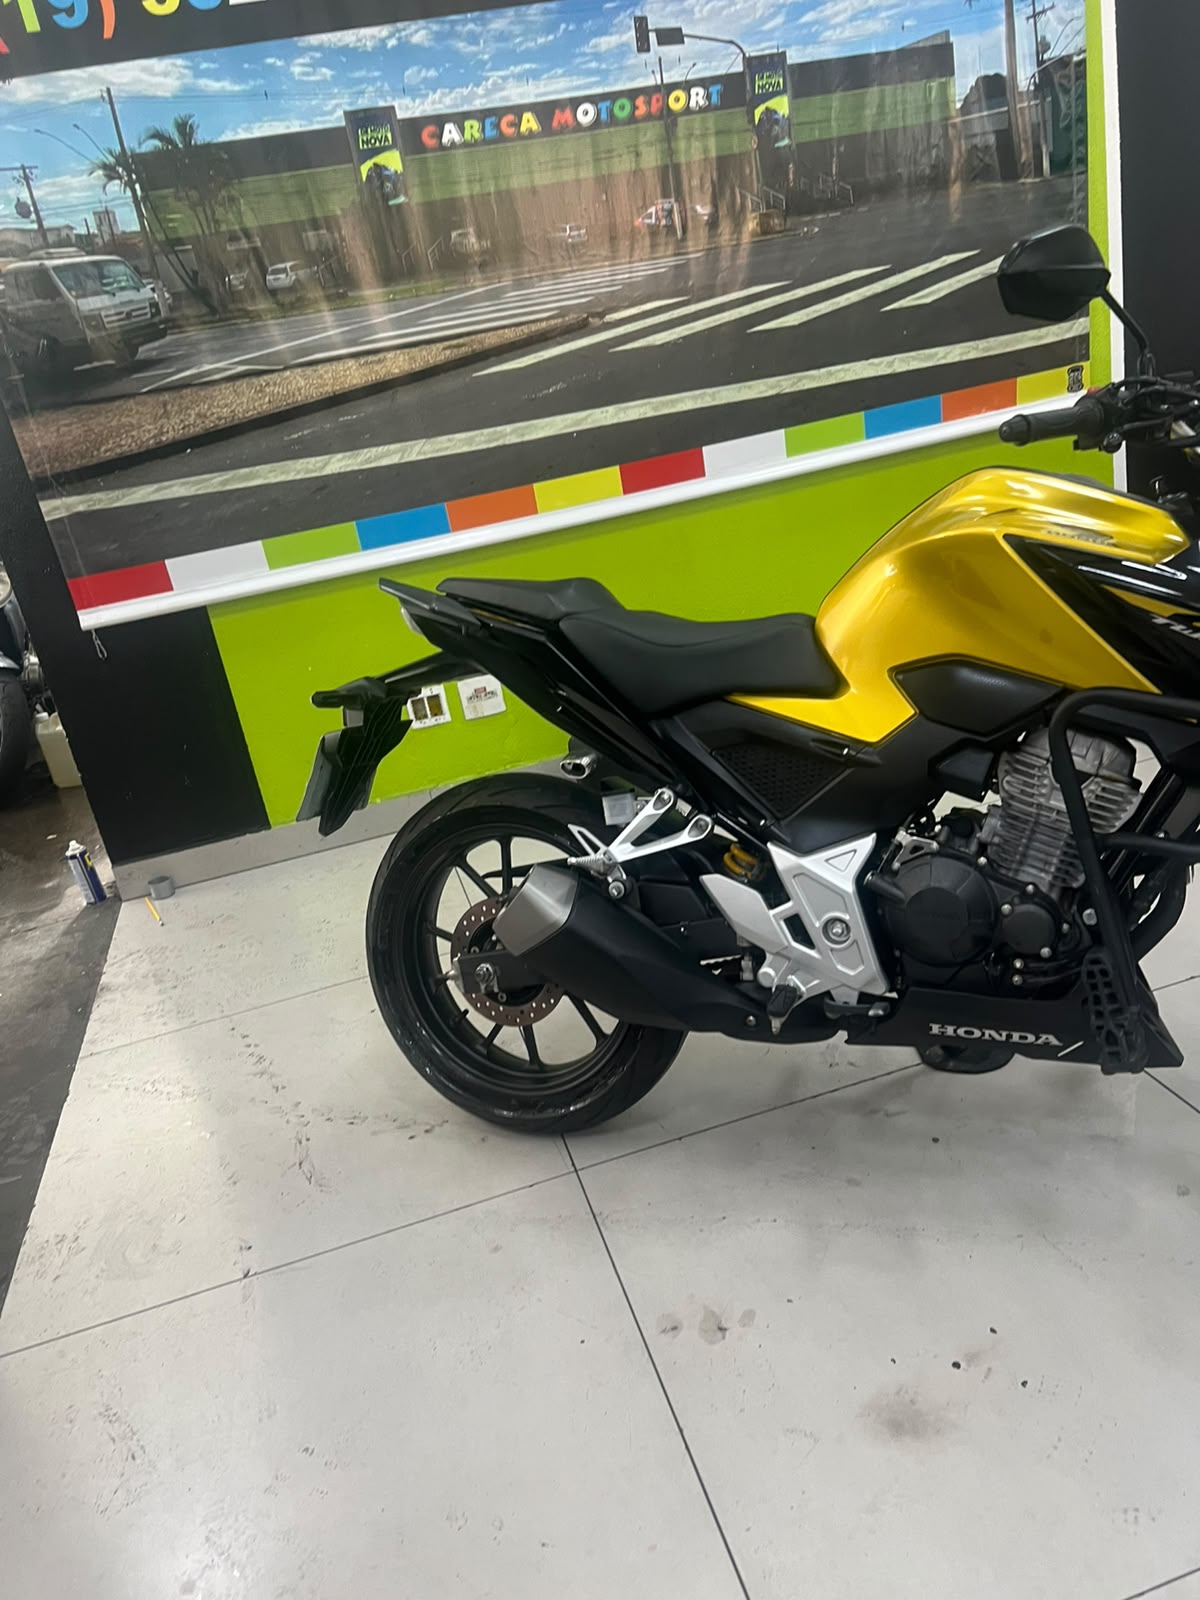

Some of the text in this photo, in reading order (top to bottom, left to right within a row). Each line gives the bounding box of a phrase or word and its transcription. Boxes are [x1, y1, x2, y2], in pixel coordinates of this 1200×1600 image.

[0, 0, 116, 54] 19)
[421, 84, 723, 149] CARECA MOTOSPORT
[360, 134, 391, 149] NOVA
[929, 1022, 1064, 1047] HONDA
